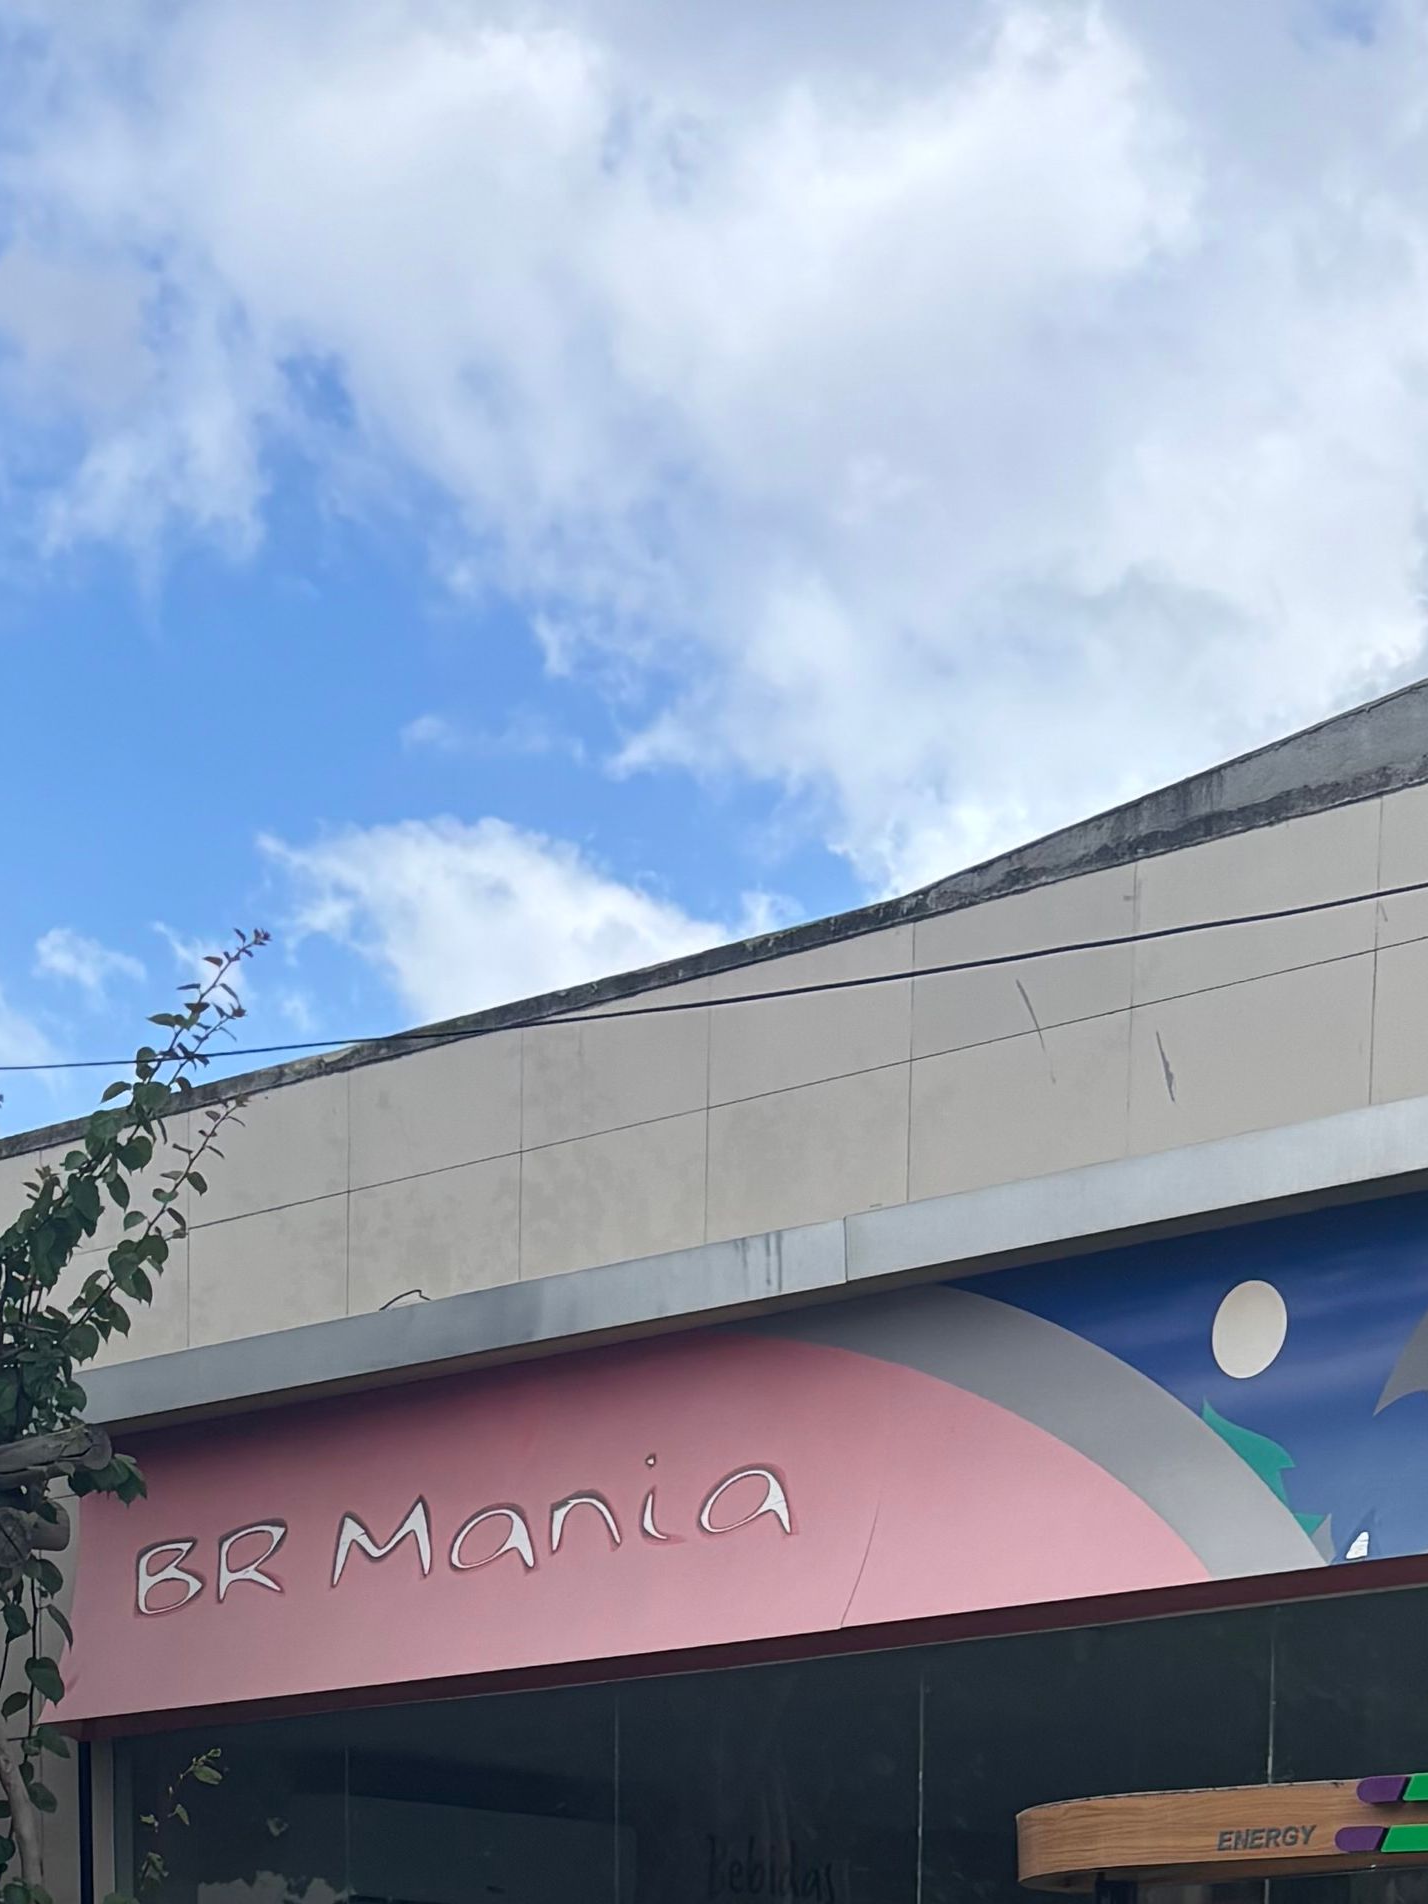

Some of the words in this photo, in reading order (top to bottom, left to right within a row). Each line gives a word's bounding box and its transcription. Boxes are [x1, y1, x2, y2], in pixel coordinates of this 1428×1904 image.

[134, 1520, 287, 1616] BR
[333, 1453, 795, 1587] Mania
[1216, 1825, 1317, 1852] ENERGY
